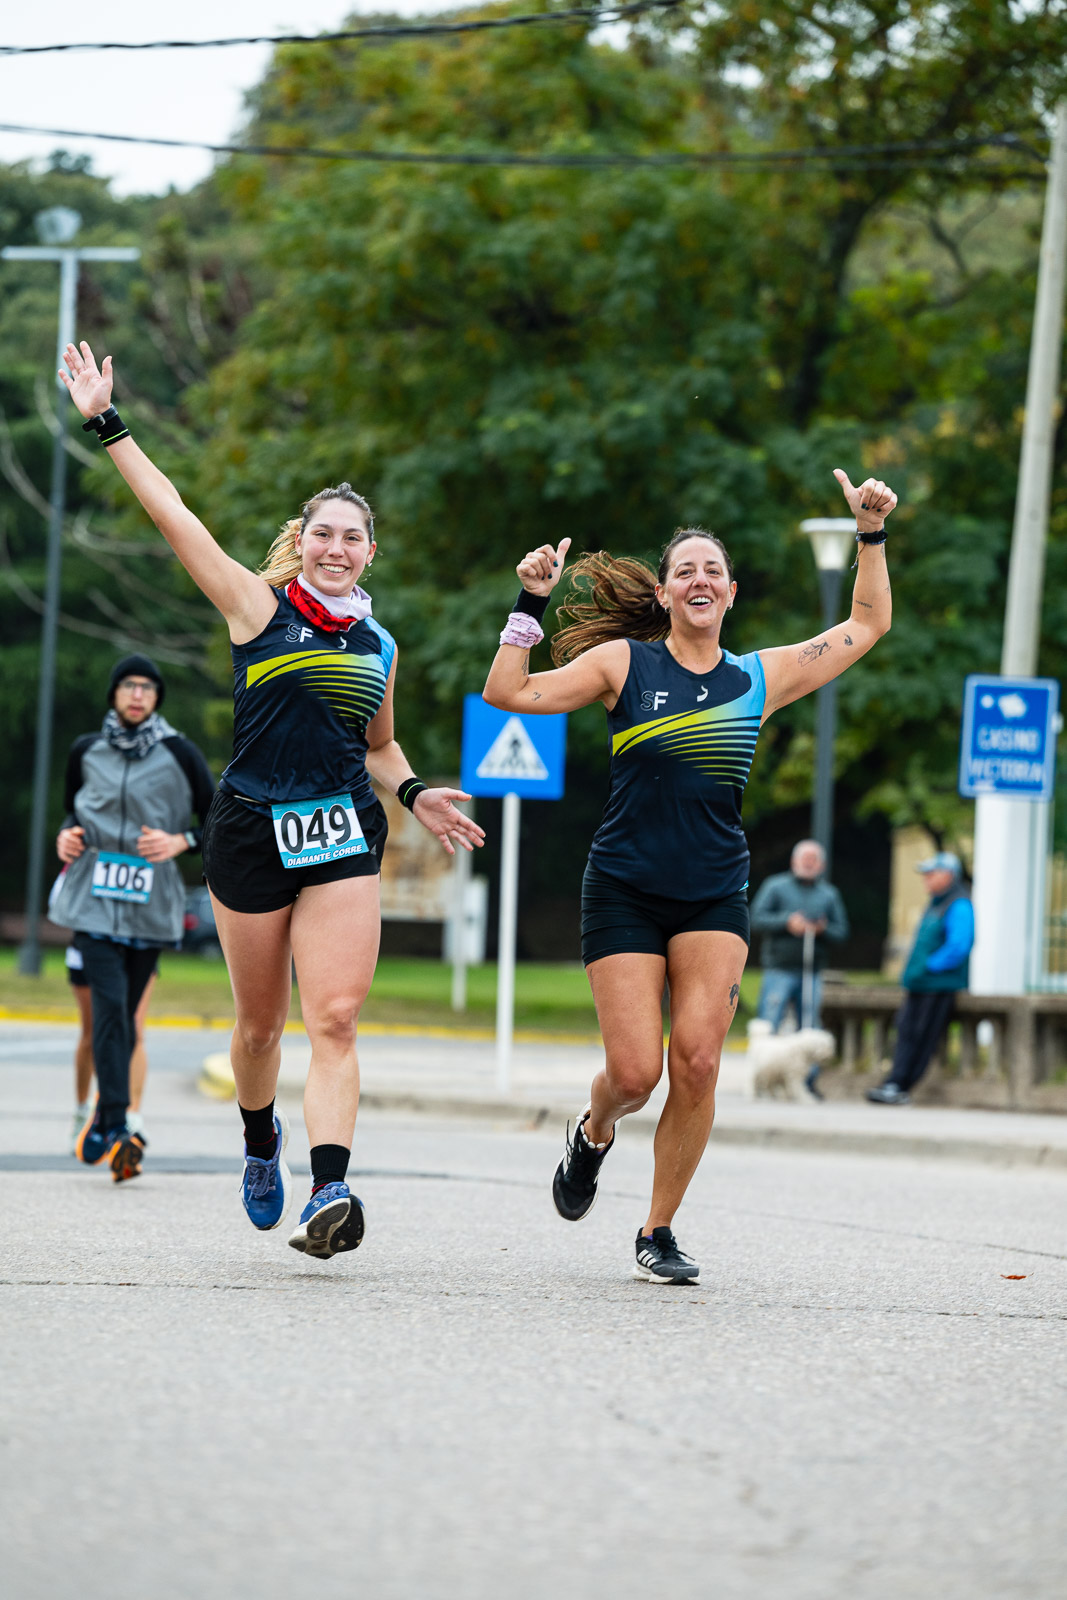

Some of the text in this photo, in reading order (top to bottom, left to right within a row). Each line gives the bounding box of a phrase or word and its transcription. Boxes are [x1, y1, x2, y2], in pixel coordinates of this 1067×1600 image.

[285, 623, 314, 643] SF
[640, 690, 669, 712] SF
[280, 803, 352, 855] 049
[287, 844, 363, 867] DIAMANTE CORRE
[103, 861, 145, 892] 106
